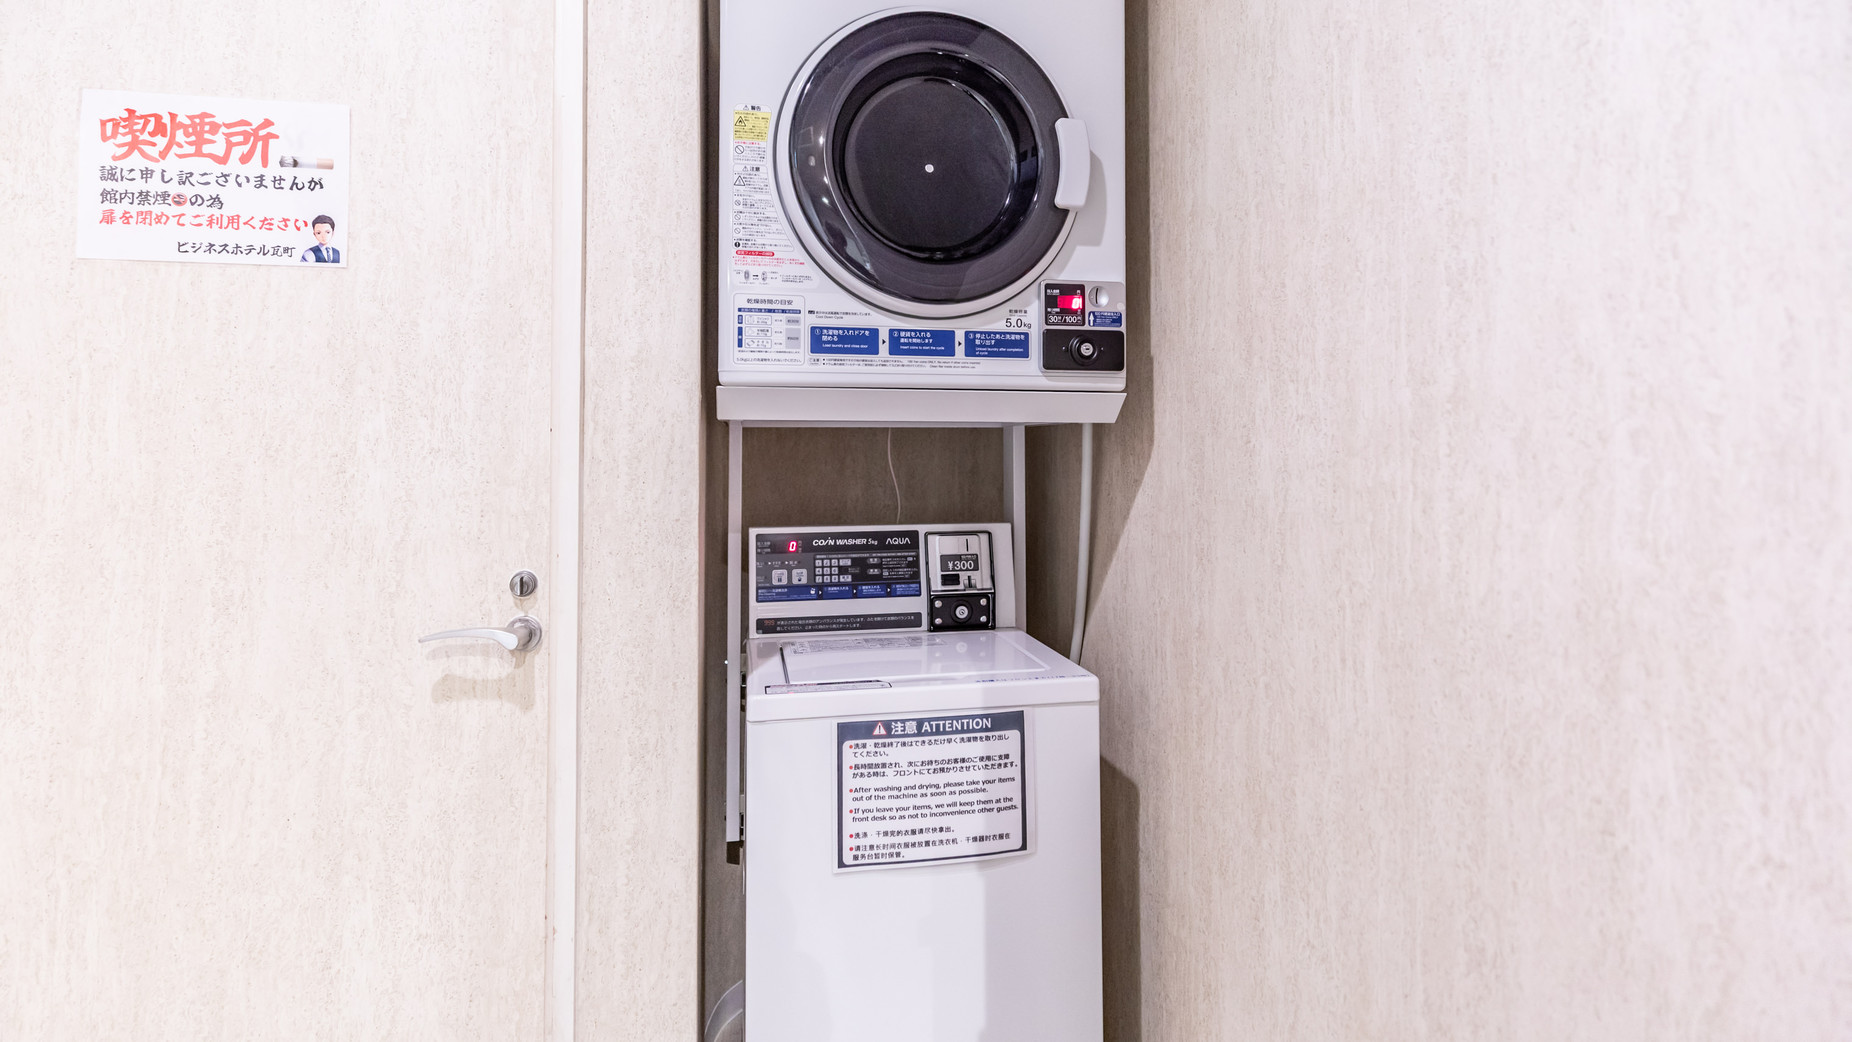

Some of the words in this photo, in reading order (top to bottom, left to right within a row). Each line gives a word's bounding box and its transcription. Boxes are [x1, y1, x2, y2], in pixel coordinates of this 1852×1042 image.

[99, 108, 279, 168] 喫煙所
[99, 165, 324, 191] 誠に申し訳ございませんが
[99, 209, 309, 232] 扉を閉めてご利用ください
[177, 241, 296, 258] ビジネスホテル瓦町
[1005, 318, 1032, 329] 5.0kg
[789, 541, 797, 552] 0
[886, 537, 911, 545] AQUA
[948, 560, 974, 570] ¥300
[891, 721, 917, 735] 注意
[921, 718, 992, 733] ATTENTION
[853, 750, 889, 758] てください。
[943, 781, 964, 789] please
[982, 778, 996, 786] your
[888, 792, 918, 800] machine
[958, 787, 988, 796] possible.
[929, 808, 976, 818] inconvenience
[996, 804, 1019, 813] guests.
